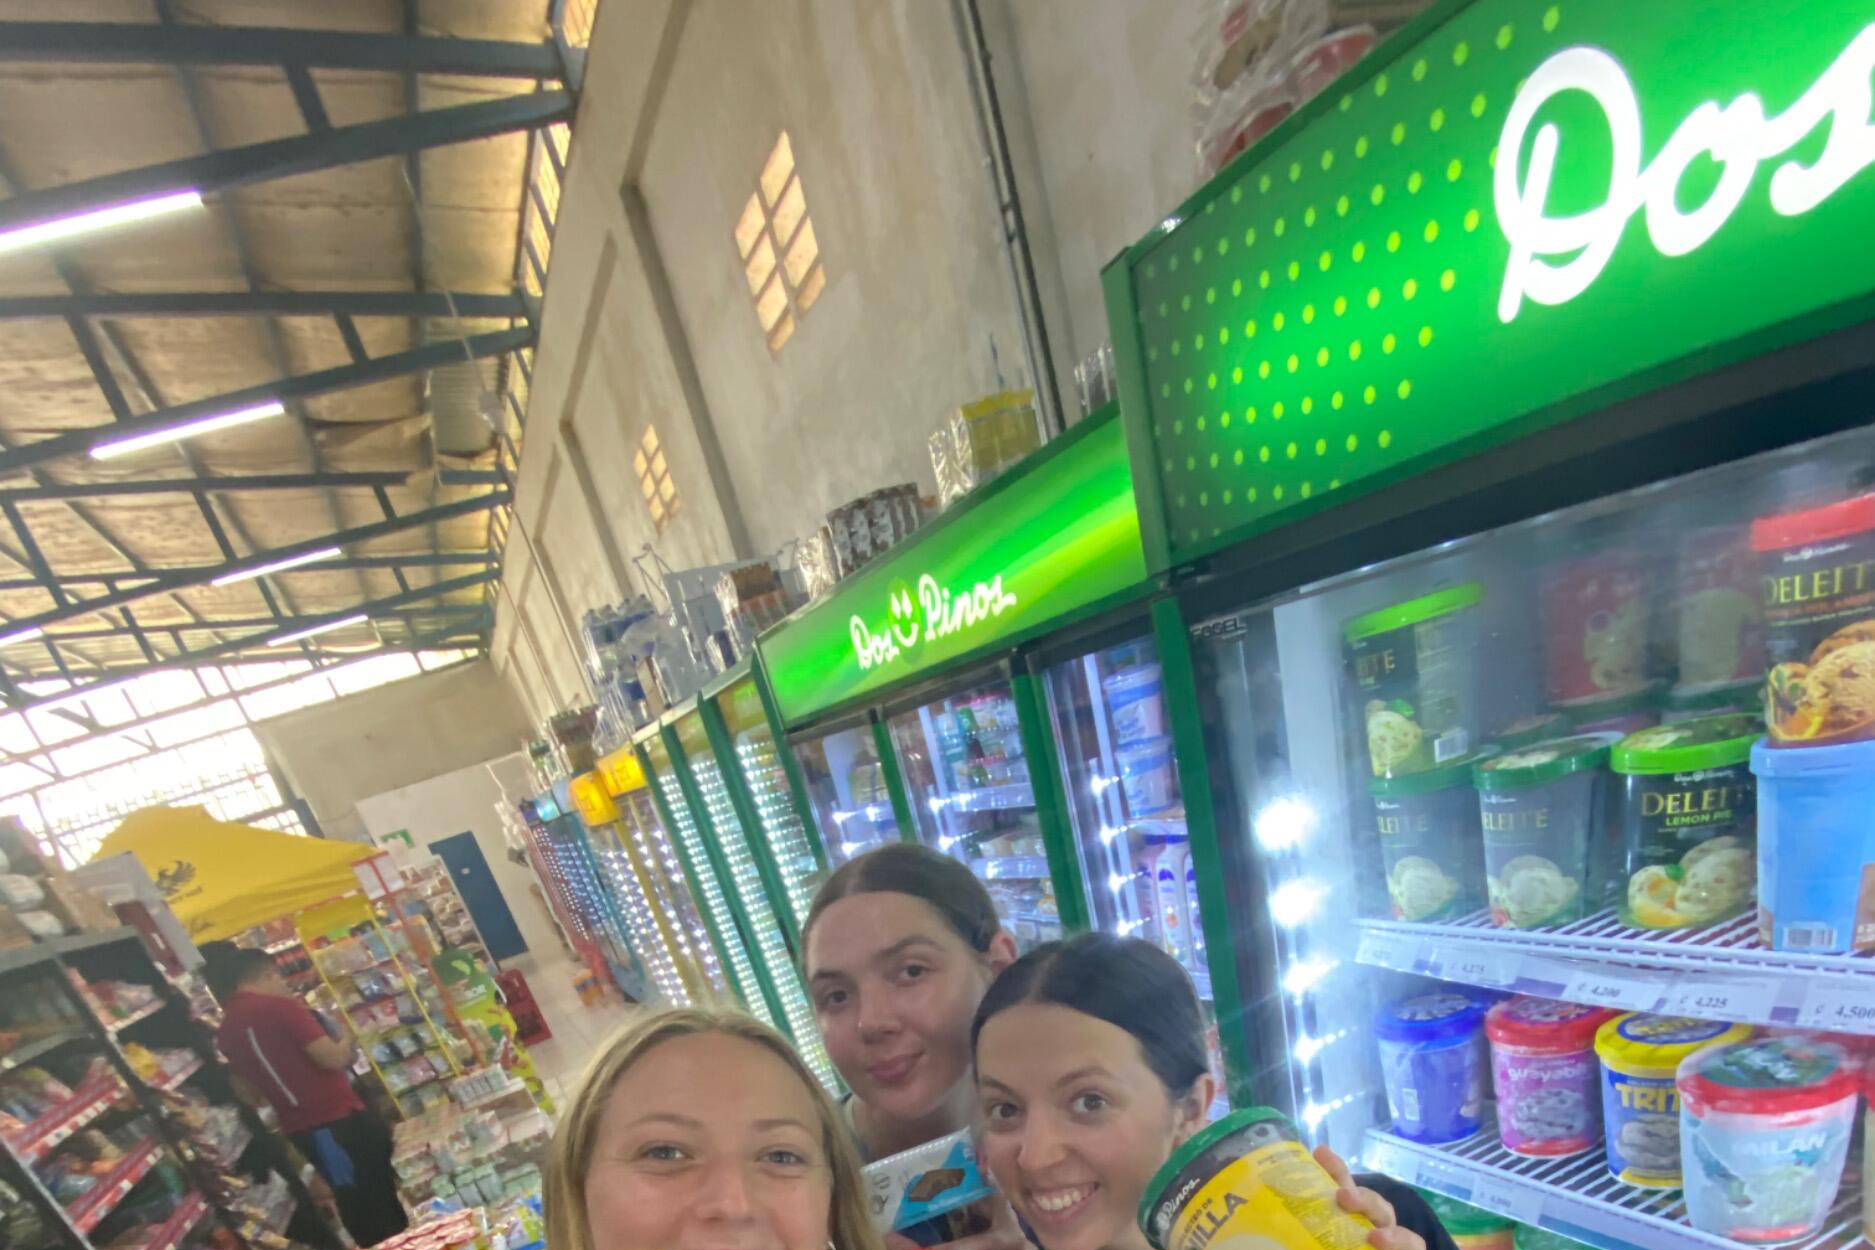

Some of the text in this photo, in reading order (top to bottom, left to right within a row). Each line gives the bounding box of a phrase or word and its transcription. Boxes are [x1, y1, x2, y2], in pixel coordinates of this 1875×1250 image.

[1764, 561, 1875, 606] DELEIT
[850, 574, 1017, 670] Dos Pinos
[1665, 813, 1711, 827] LEMON
[1615, 1083, 1680, 1113] TRIT
